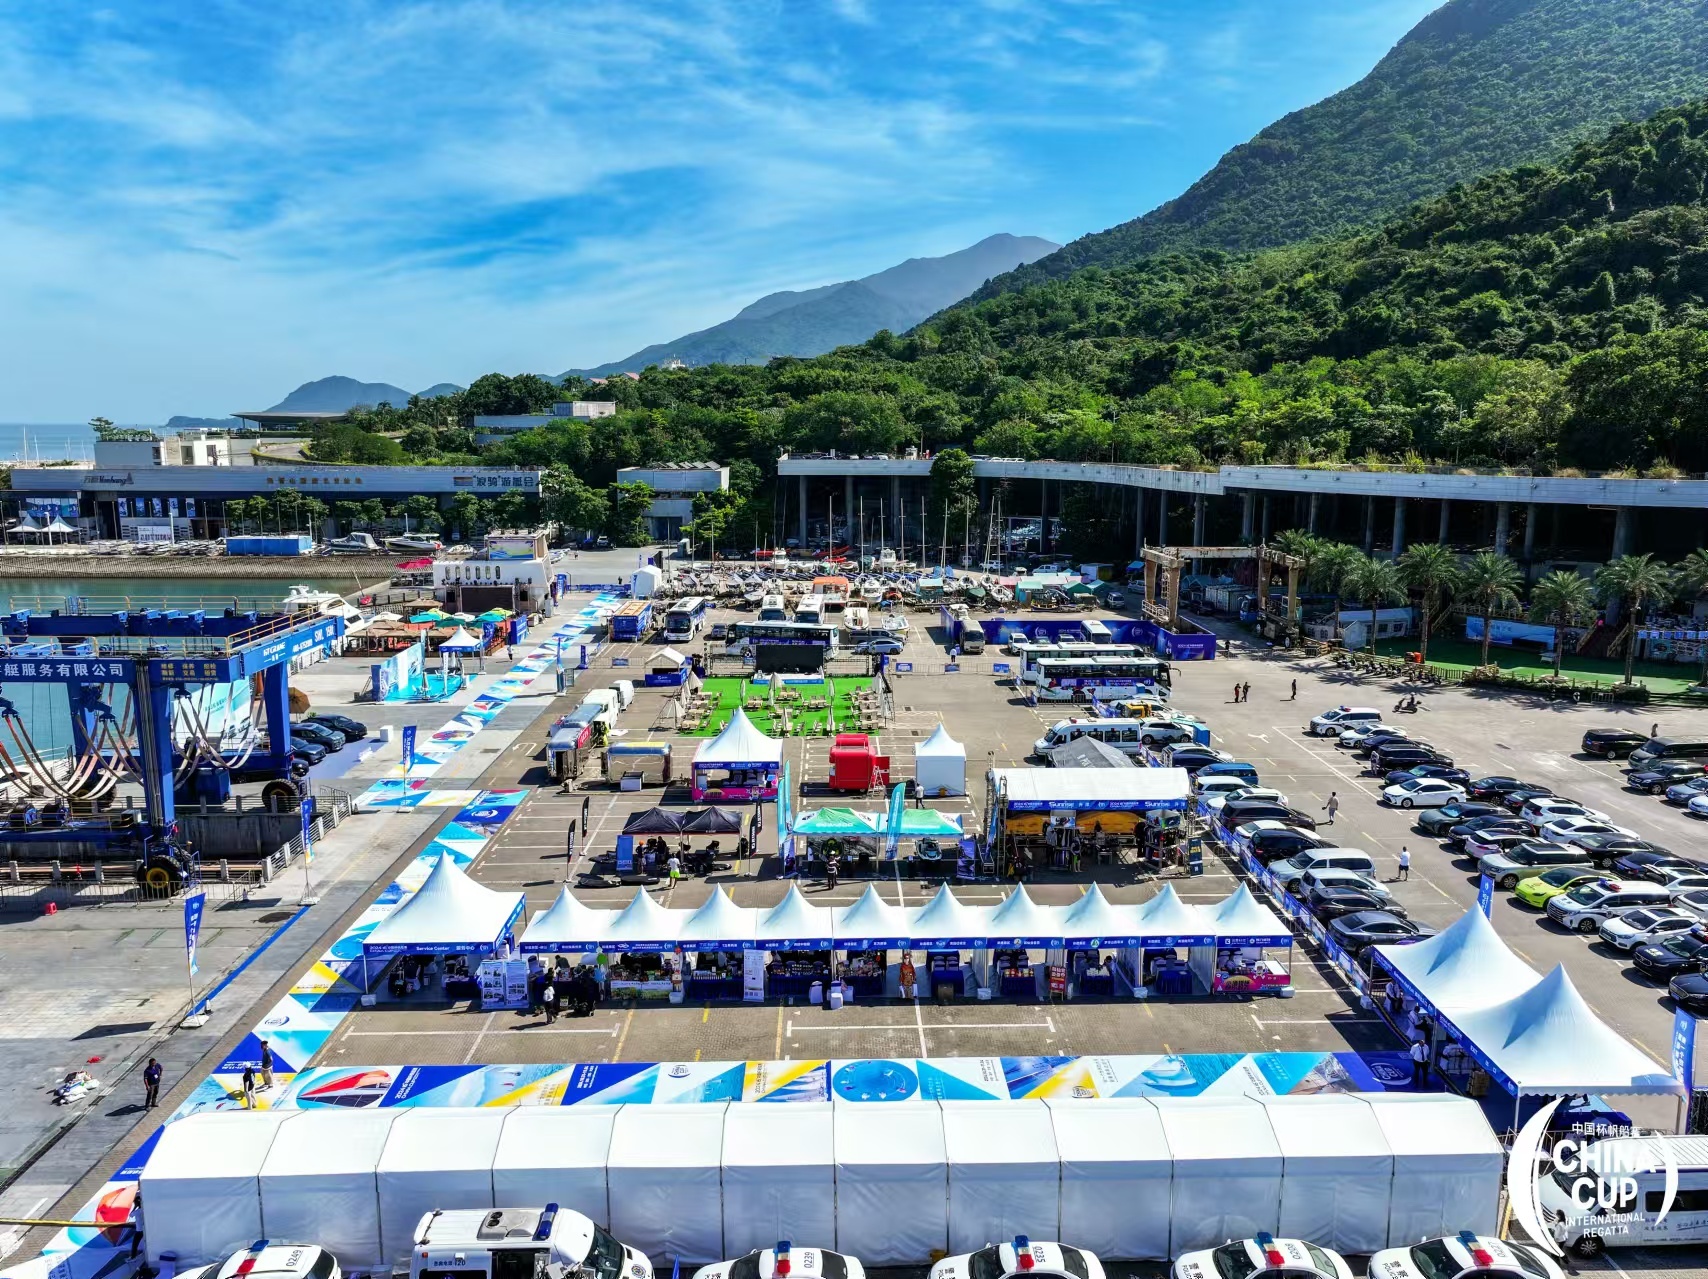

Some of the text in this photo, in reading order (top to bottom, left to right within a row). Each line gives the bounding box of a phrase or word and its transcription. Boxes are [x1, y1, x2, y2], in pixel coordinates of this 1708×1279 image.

[0, 663, 123, 677] 艇服务有限公司
[285, 1249, 303, 1267] 0249
[804, 1251, 815, 1269] 0239
[1032, 1246, 1046, 1263] 0235
